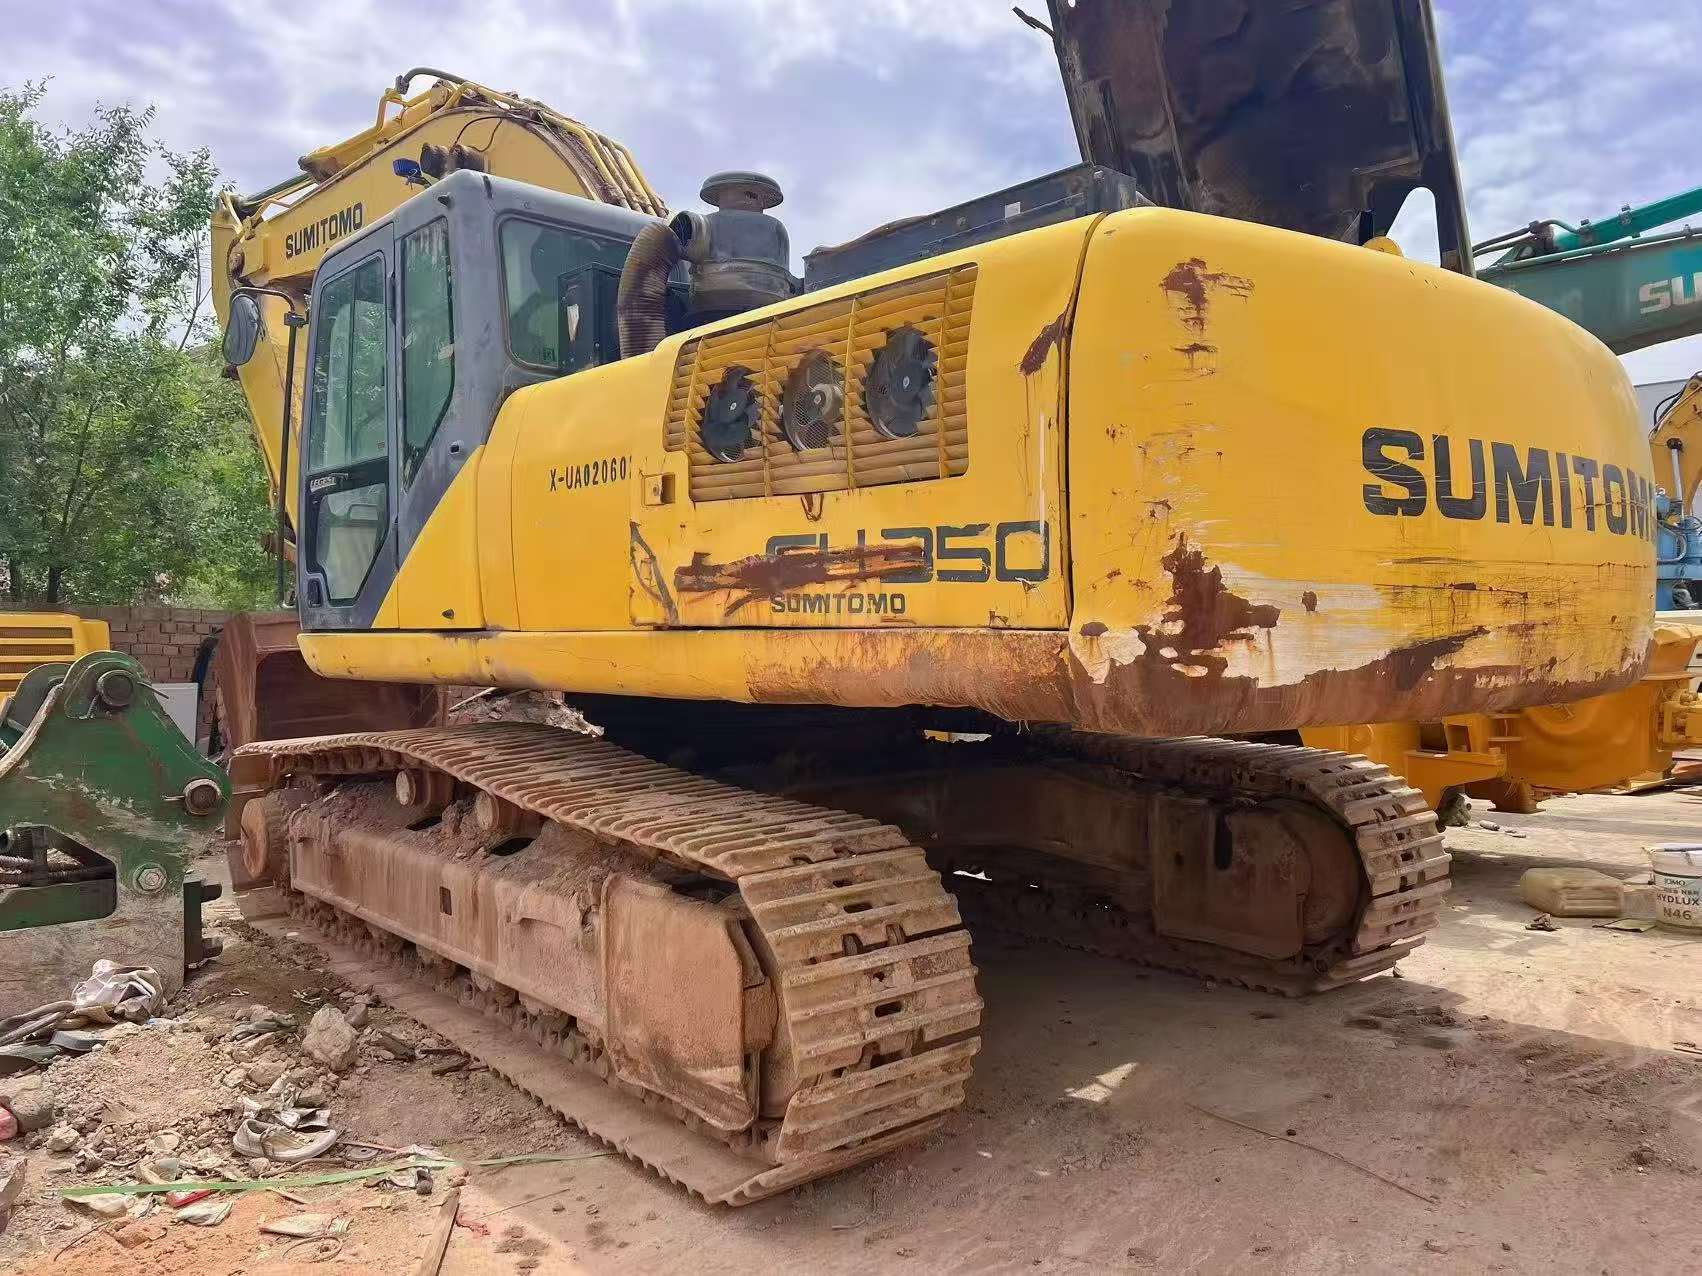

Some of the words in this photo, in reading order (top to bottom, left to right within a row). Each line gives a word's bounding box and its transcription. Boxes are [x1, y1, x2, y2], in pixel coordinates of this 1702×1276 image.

[286, 202, 363, 259] SUMITOMO
[550, 456, 632, 491] X-UA02060
[1362, 427, 1655, 543] SUMITOM
[770, 593, 906, 614] SUMITOMO
